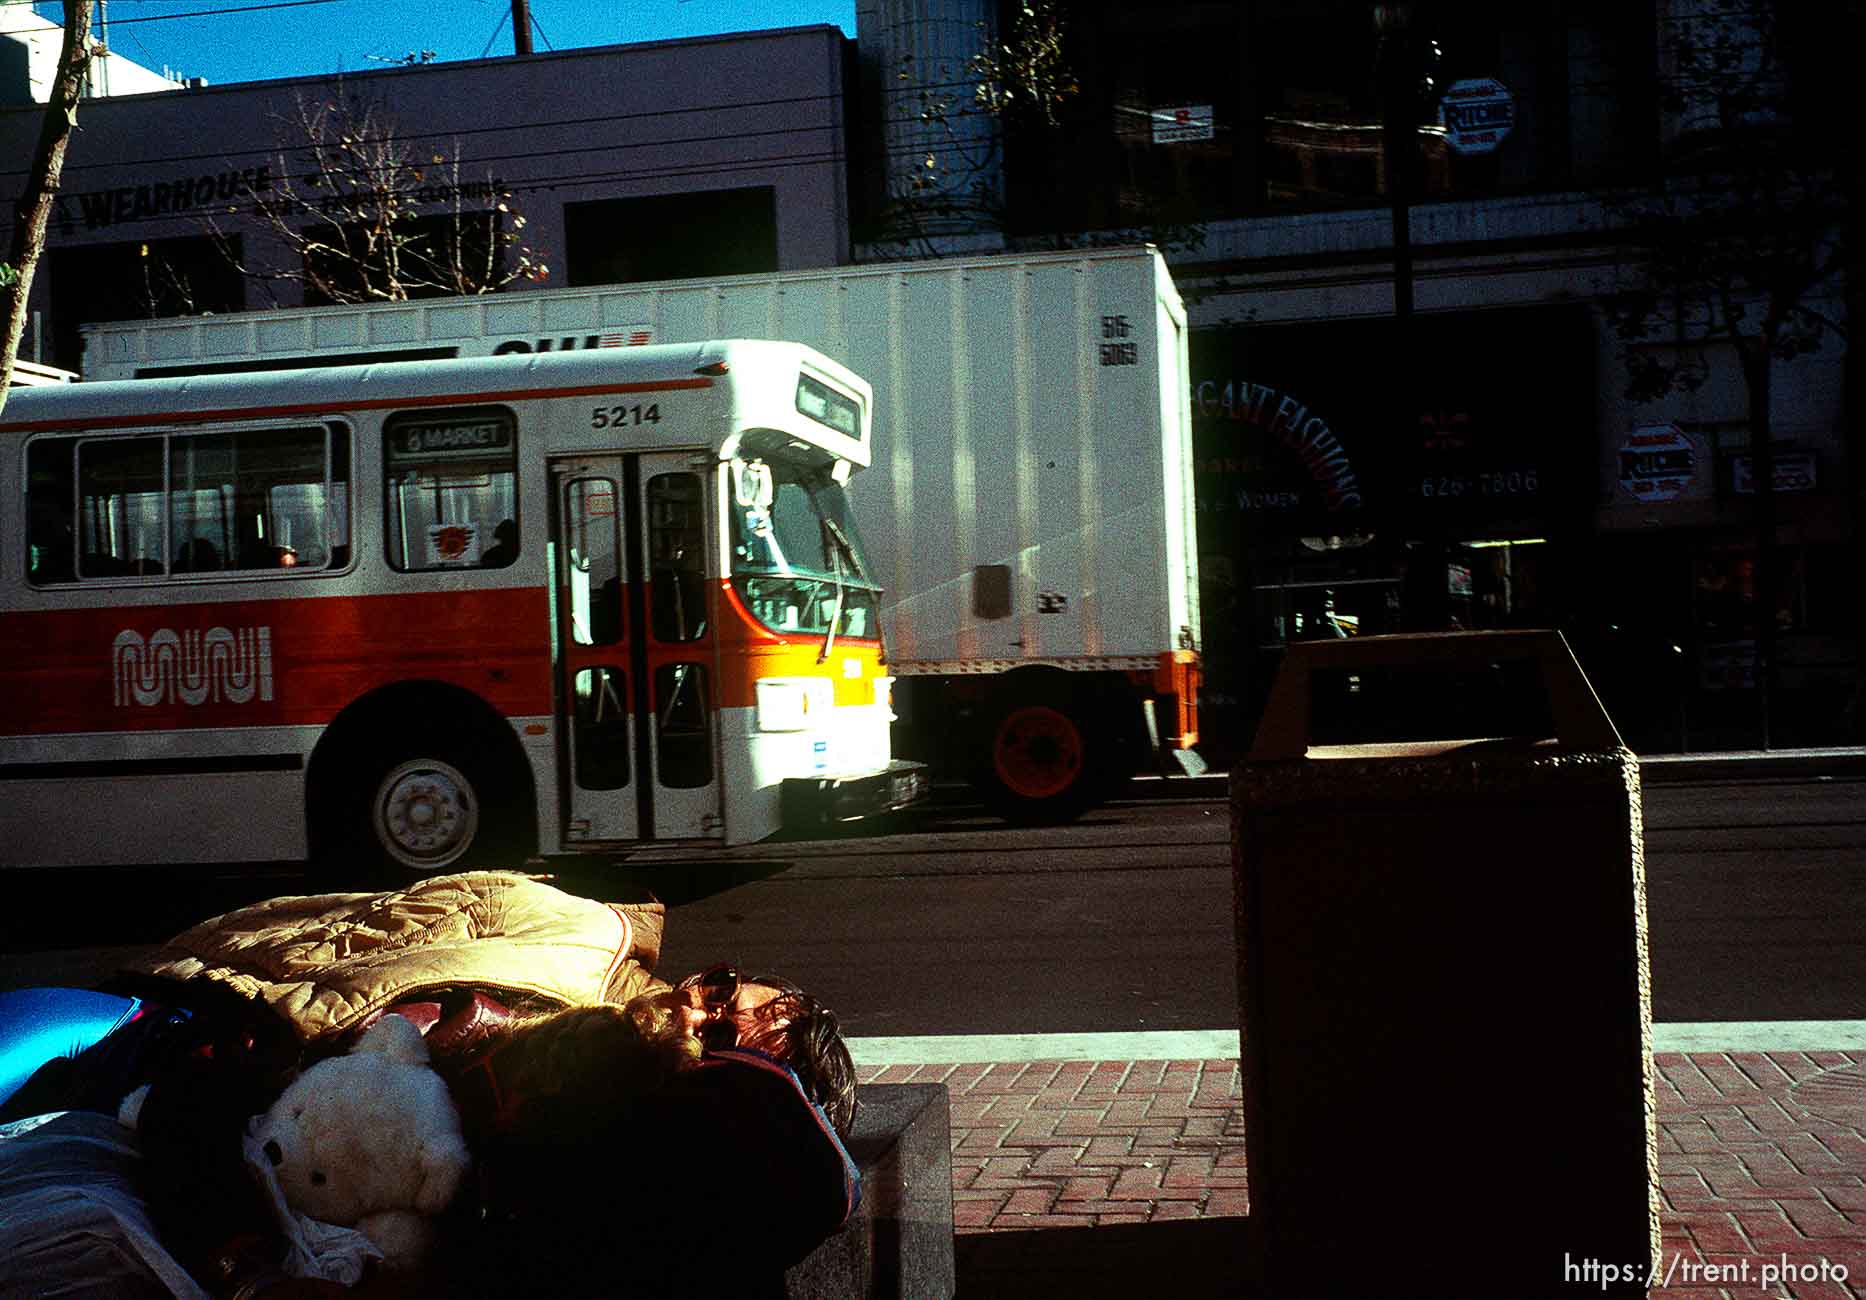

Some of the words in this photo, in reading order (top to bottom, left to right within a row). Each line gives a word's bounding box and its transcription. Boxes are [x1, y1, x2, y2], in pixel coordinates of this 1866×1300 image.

[79, 166, 271, 231] WEARHOUSE
[592, 403, 662, 428] 5214
[1191, 377, 1277, 424] GANT
[424, 424, 499, 447] MARKET
